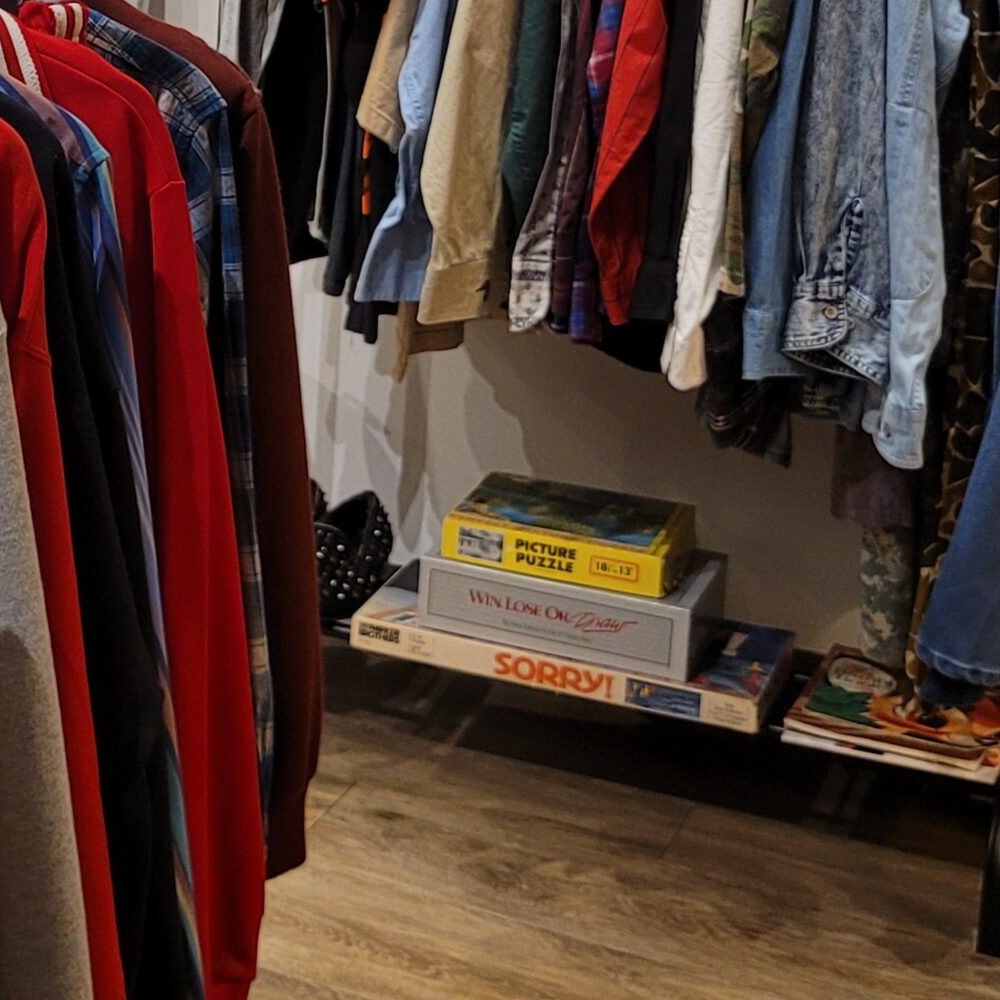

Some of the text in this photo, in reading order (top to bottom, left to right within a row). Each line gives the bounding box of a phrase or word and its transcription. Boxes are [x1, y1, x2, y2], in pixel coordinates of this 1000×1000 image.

[515, 538, 577, 560] PICTURE
[516, 551, 574, 573] PUZZLE
[505, 597, 541, 617] LOSE
[545, 605, 570, 623] OR
[571, 611, 638, 633] Draw
[493, 652, 616, 698] SORRY!
